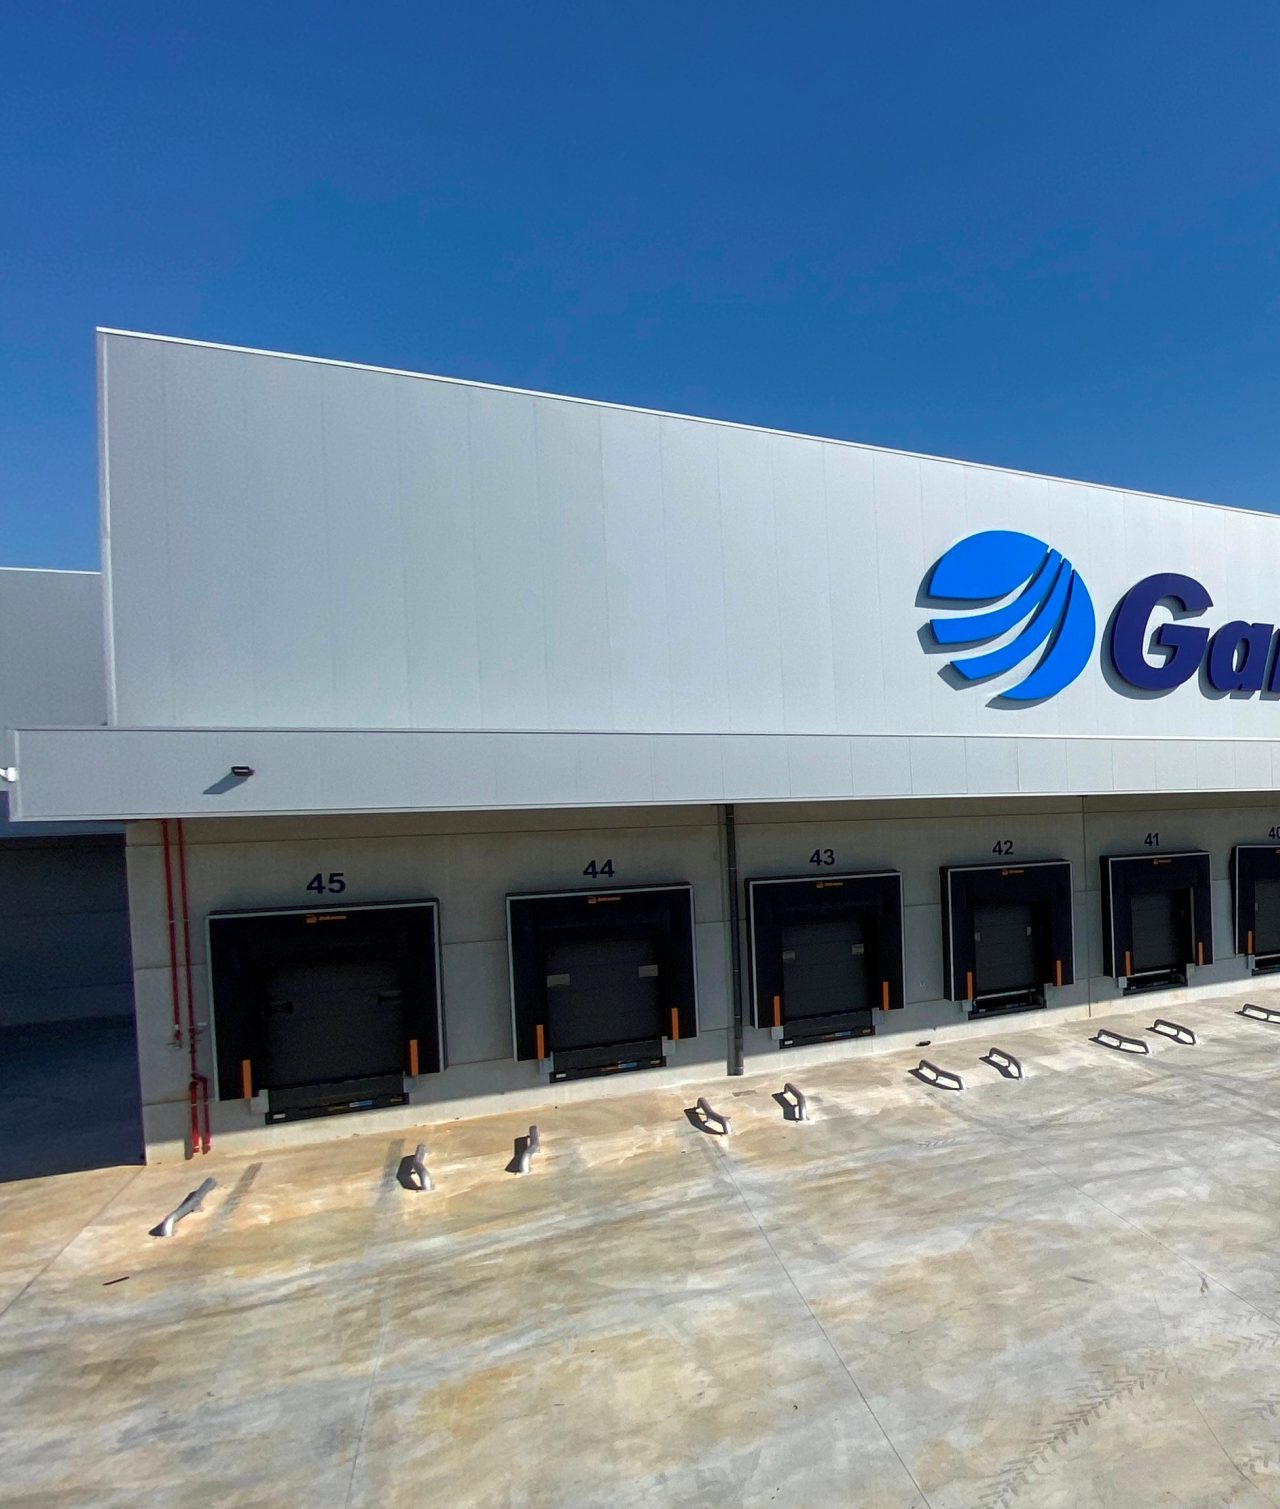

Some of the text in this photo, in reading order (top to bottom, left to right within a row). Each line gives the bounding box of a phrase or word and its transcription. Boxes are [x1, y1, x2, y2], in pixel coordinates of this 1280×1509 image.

[992, 839, 1014, 856] 42
[1144, 832, 1160, 847] 41
[809, 848, 836, 866] 43
[583, 859, 615, 878] 44
[306, 872, 346, 894] 45
